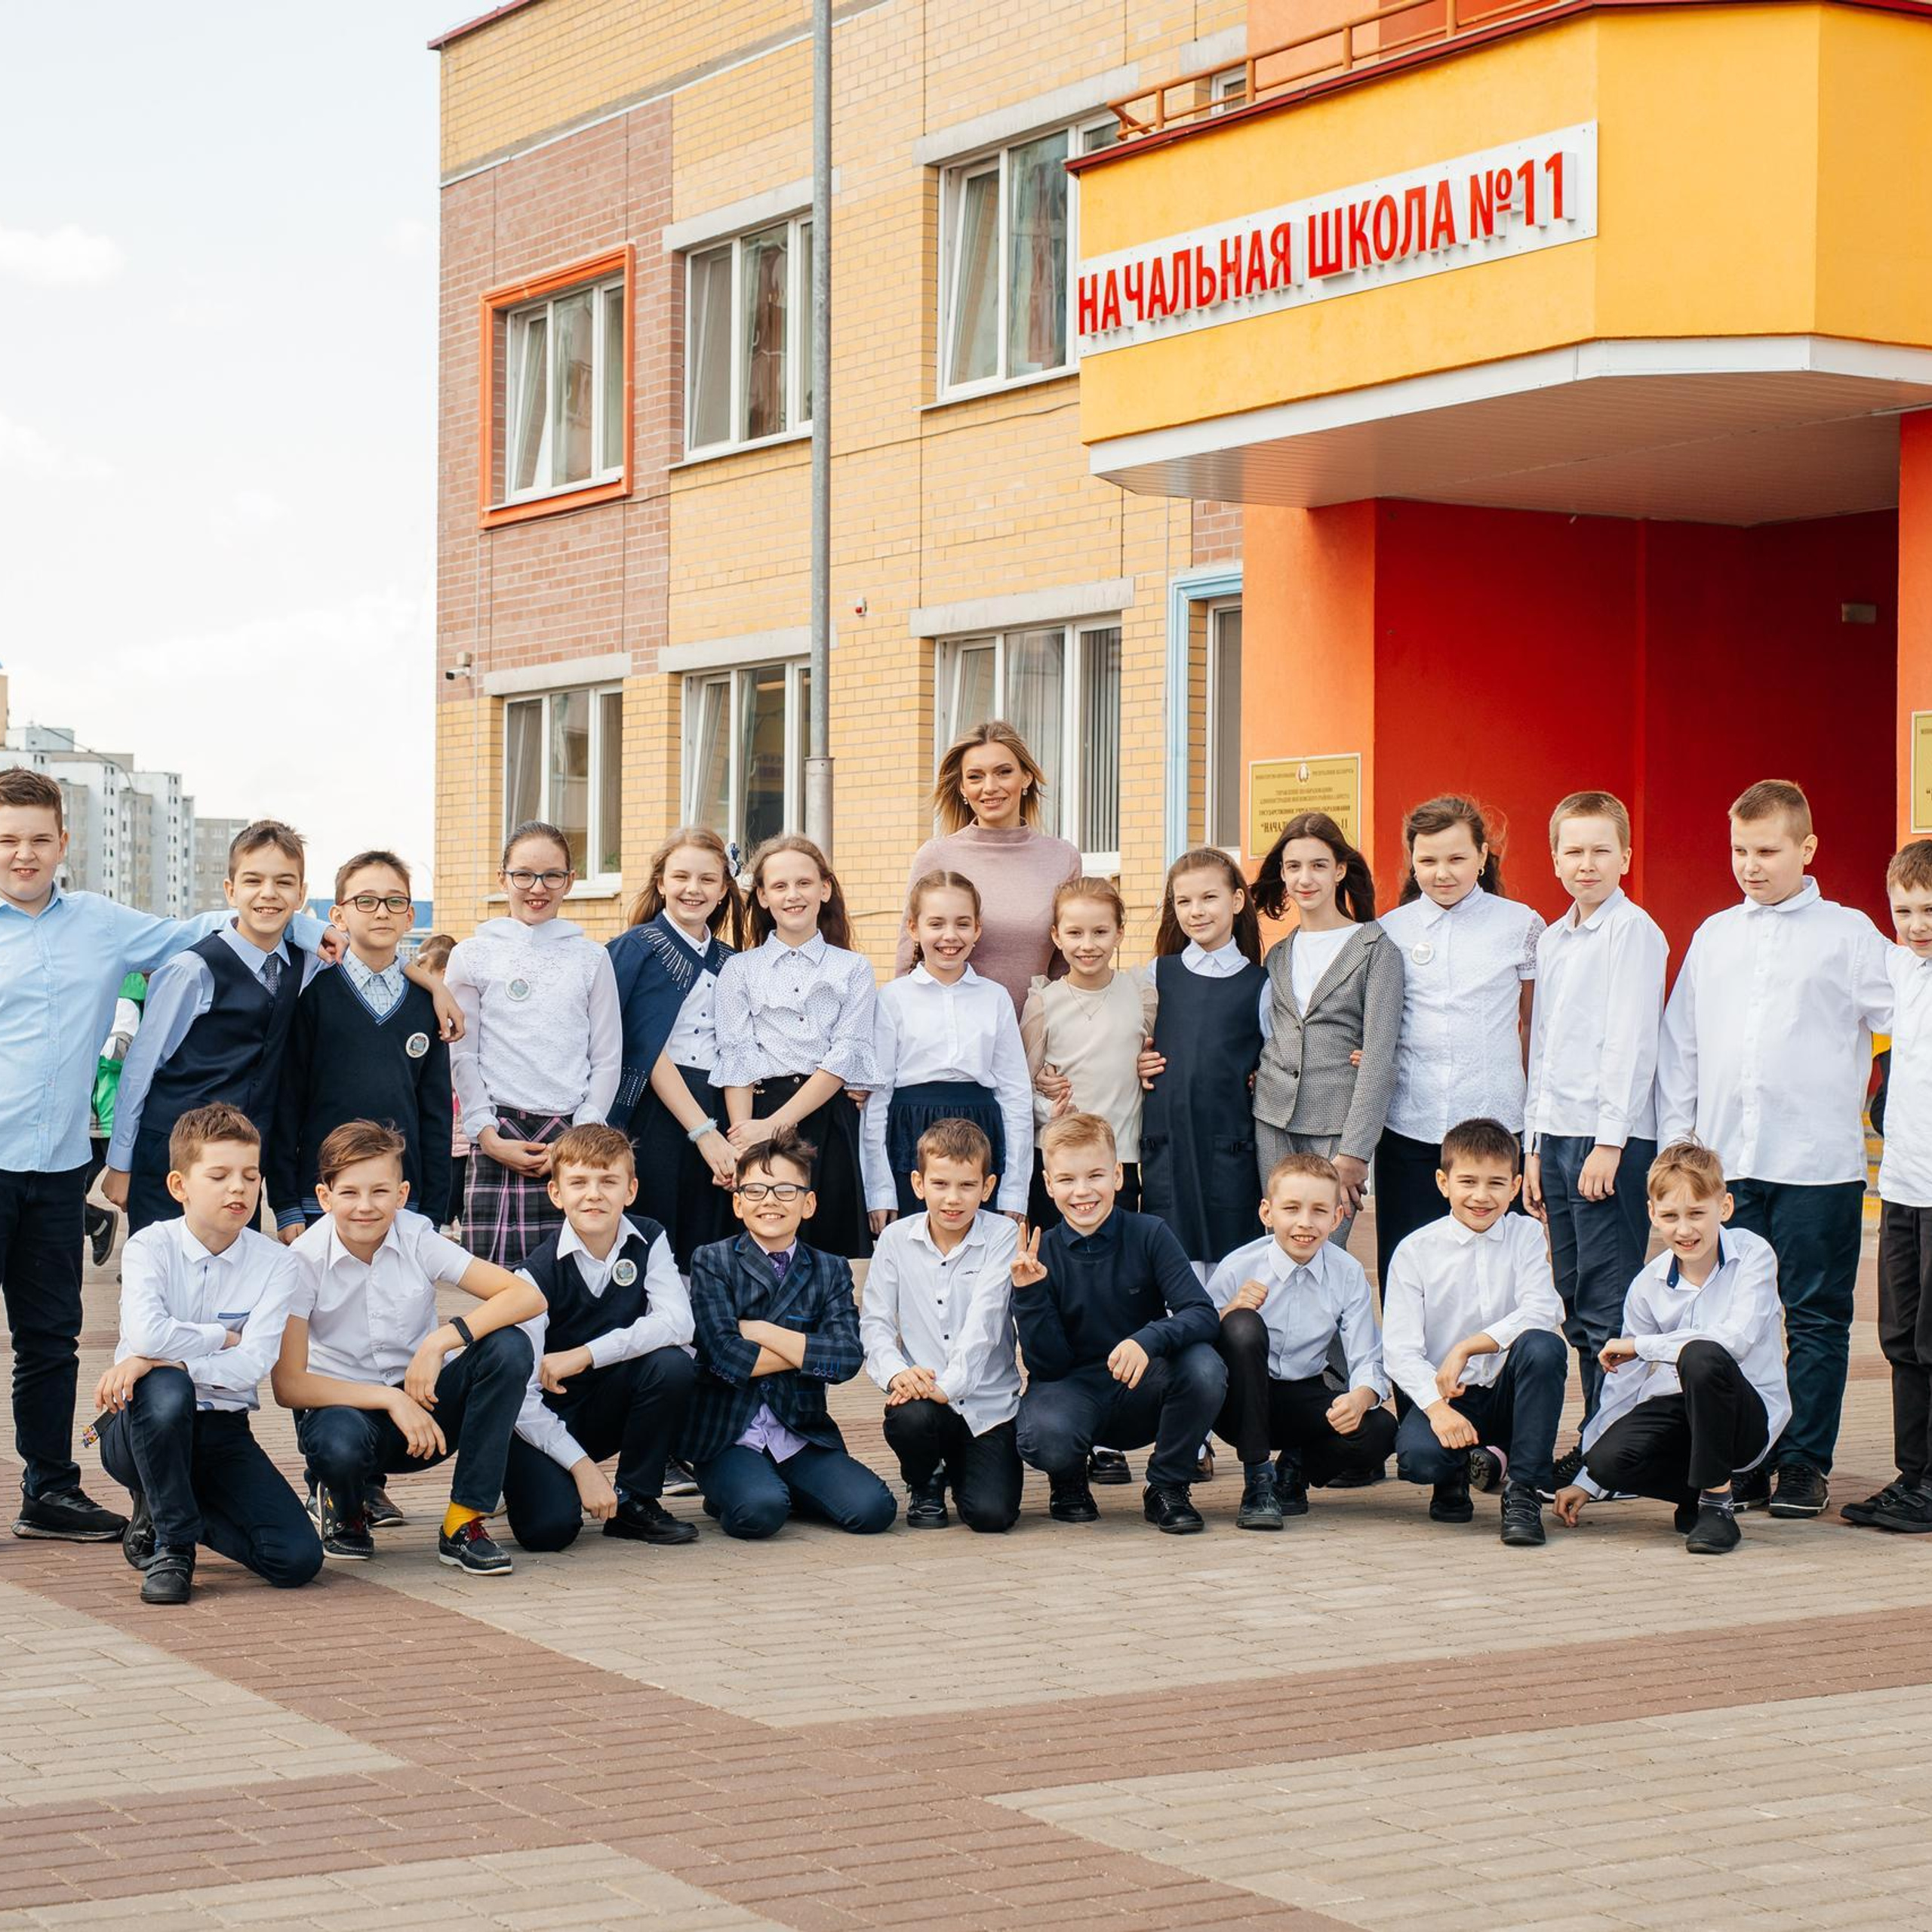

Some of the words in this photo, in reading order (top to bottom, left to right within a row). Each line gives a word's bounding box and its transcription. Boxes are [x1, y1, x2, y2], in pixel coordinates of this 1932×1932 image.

[1078, 223, 1291, 335] НАЧАЛЬНАЯ
[1309, 180, 1457, 278] ШКОЛА
[1470, 152, 1563, 239] №11
